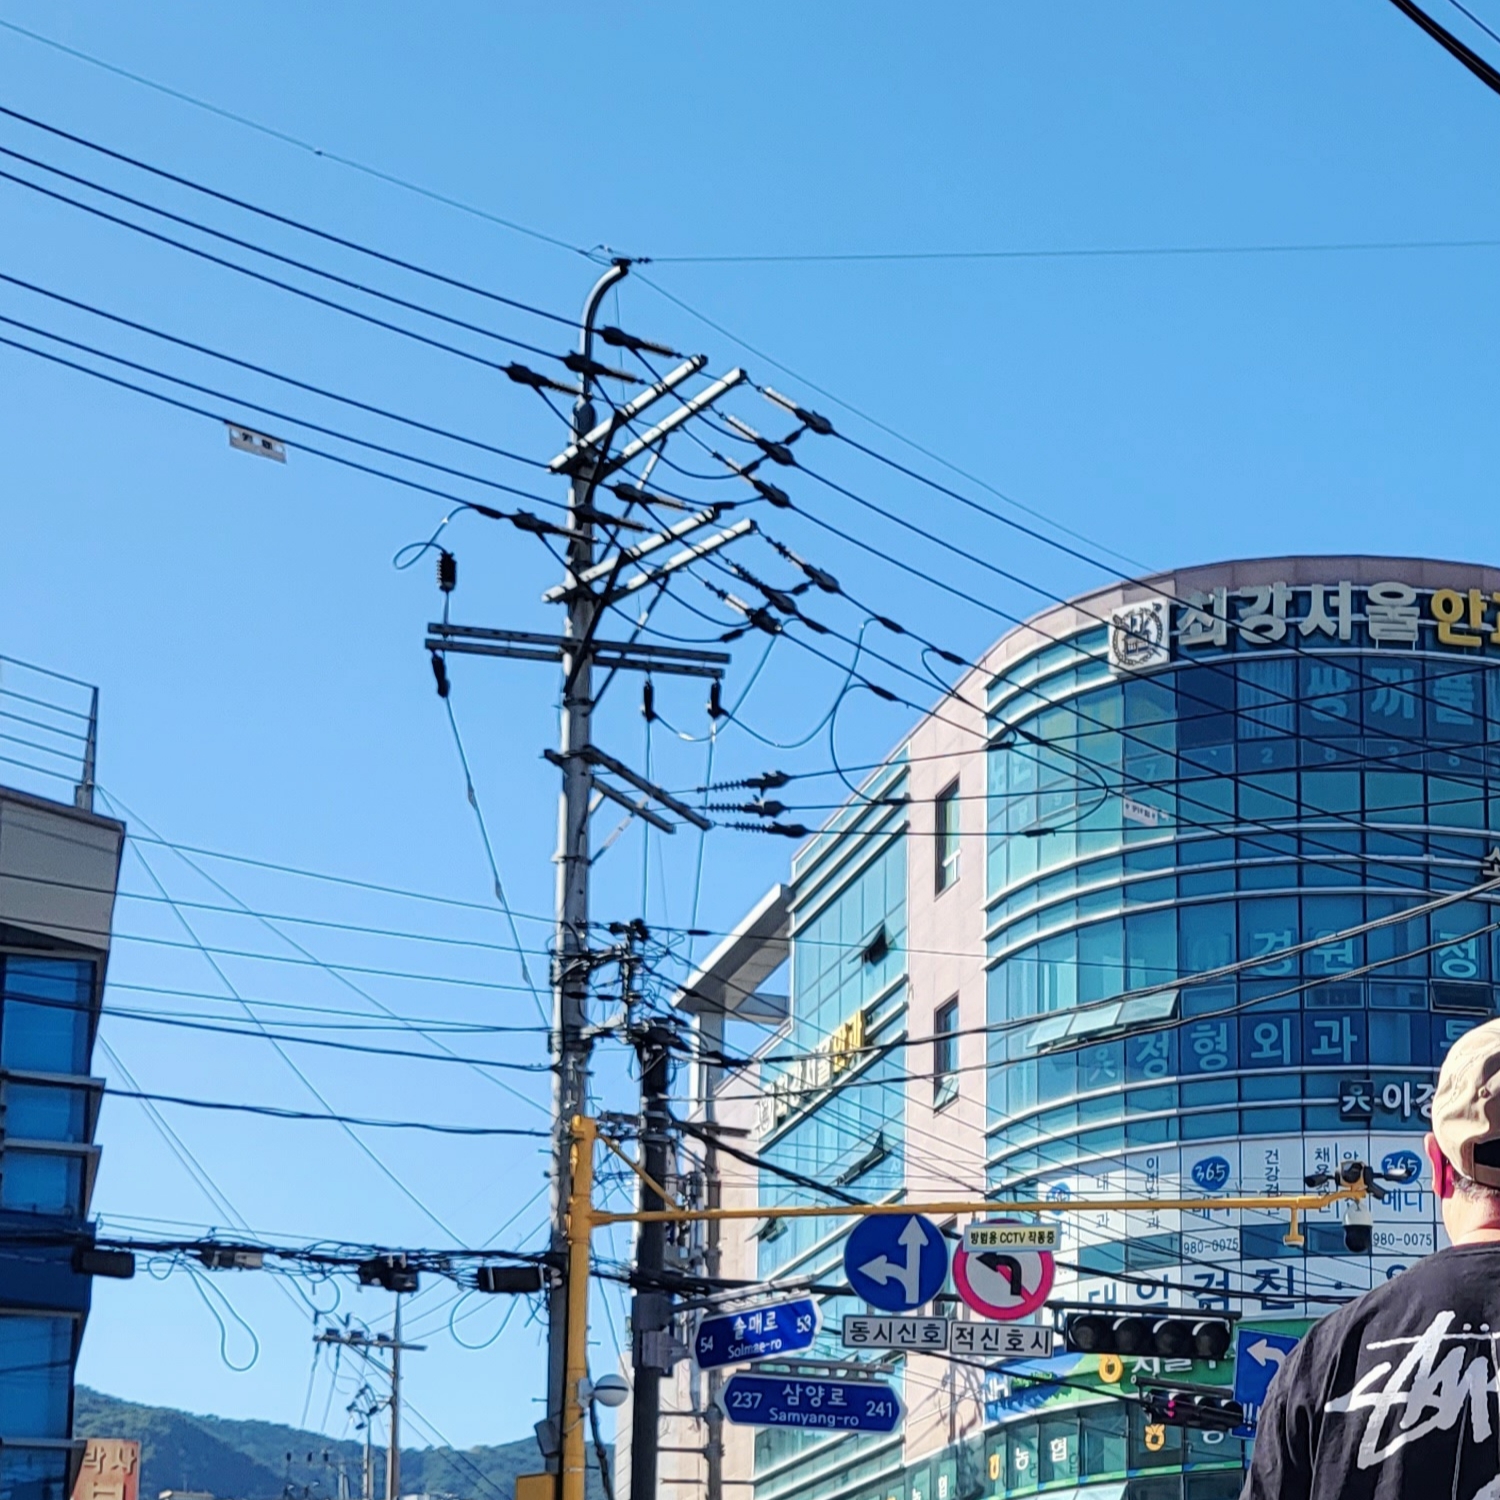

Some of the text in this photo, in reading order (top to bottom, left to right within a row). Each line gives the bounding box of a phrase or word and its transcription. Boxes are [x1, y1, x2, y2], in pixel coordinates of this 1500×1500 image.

[1136, 1017, 1359, 1079] 정형외과
[1194, 1161, 1227, 1183] 365
[1381, 1188, 1424, 1213] 메디
[999, 1231, 1026, 1244] CCTV
[1028, 1231, 1055, 1245] 작동중
[1183, 1238, 1240, 1256] 980-0075
[1372, 1232, 1433, 1247] 980-0075
[700, 1335, 714, 1353] 54
[732, 1310, 779, 1341] 솔매로
[849, 1321, 942, 1345] 동시신호
[954, 1327, 1051, 1355] 적신호시
[727, 1338, 782, 1359] Solmae-ro
[731, 1383, 894, 1419] 237 삼양로 241
[769, 1406, 860, 1428] Samyang-ro
